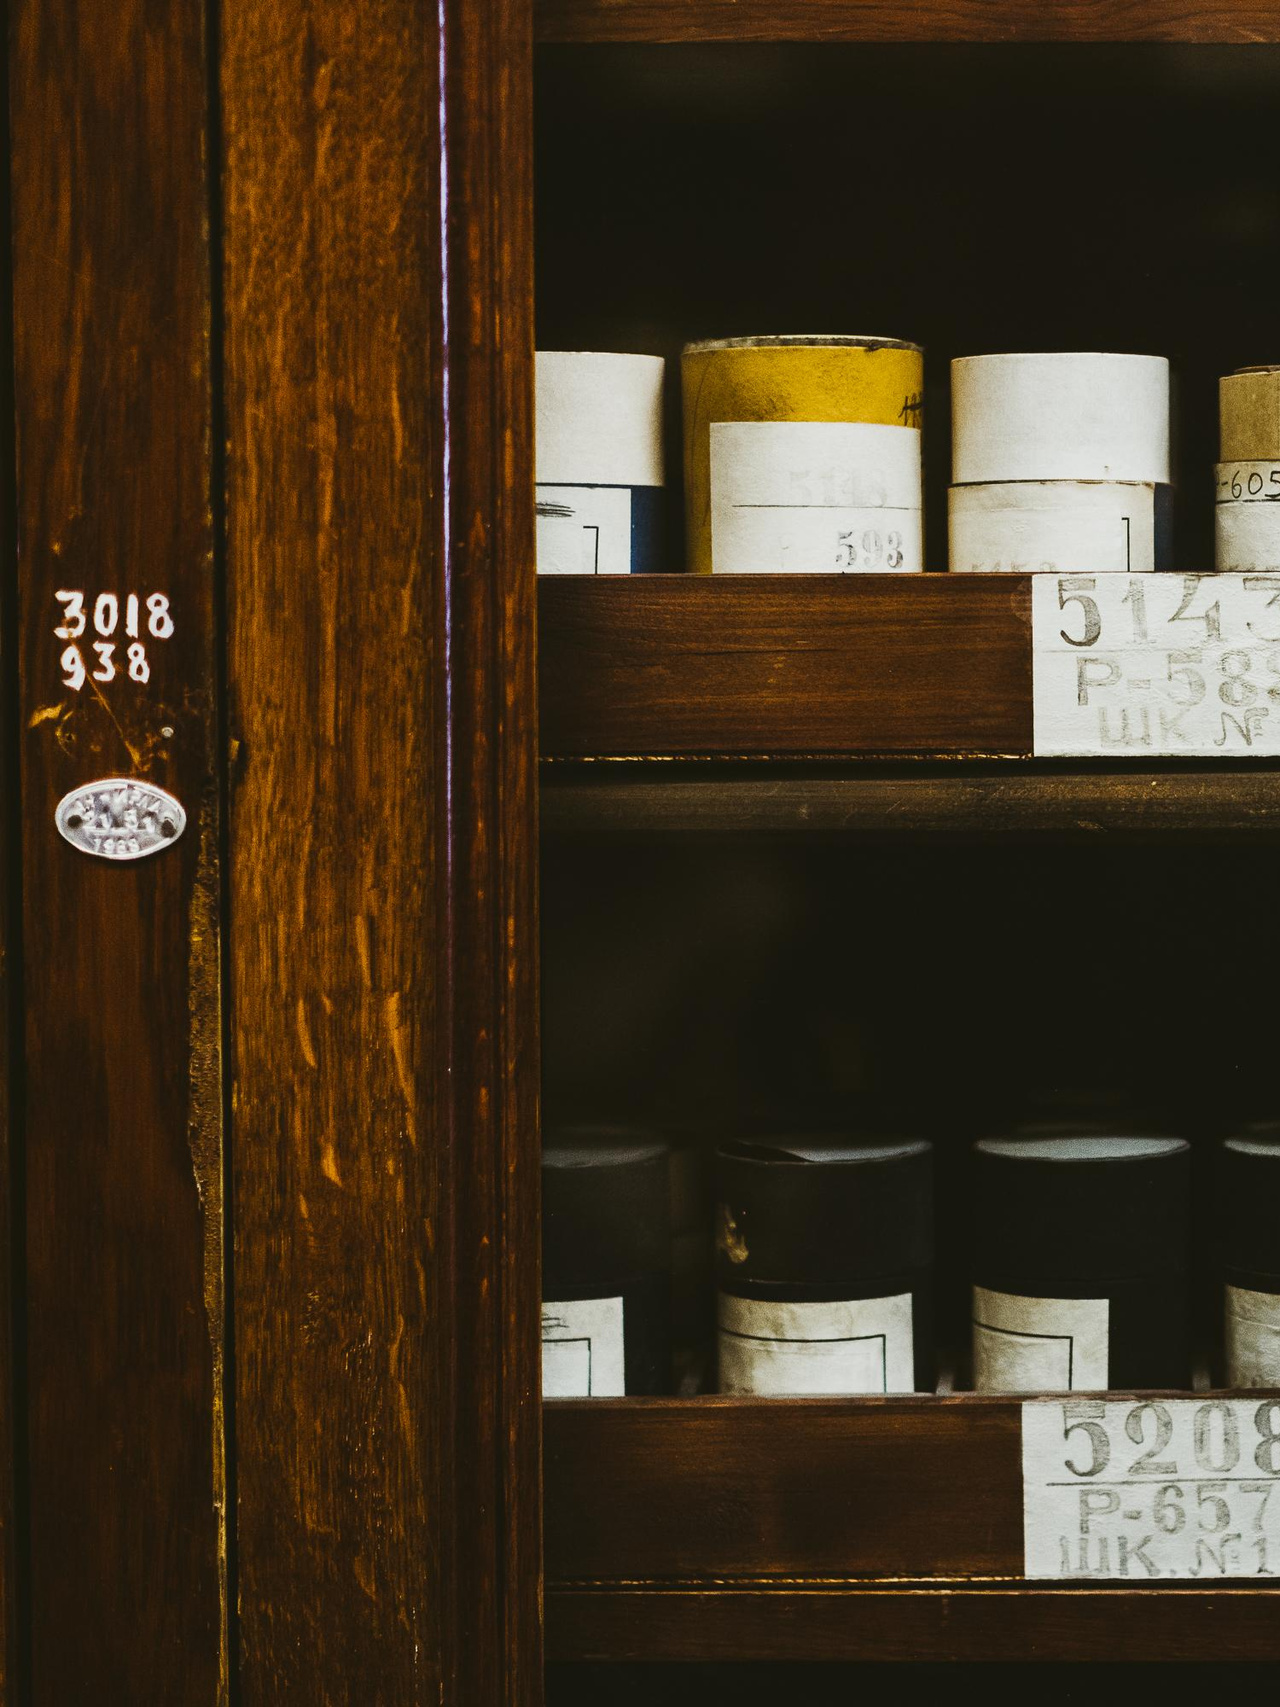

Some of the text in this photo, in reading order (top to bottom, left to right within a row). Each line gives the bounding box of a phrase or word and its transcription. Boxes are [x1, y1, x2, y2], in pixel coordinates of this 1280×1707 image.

[836, 530, 904, 568] 593
[53, 590, 175, 640] 3018
[60, 640, 150, 691] 938
[1079, 1481, 1273, 1535] Р-657
